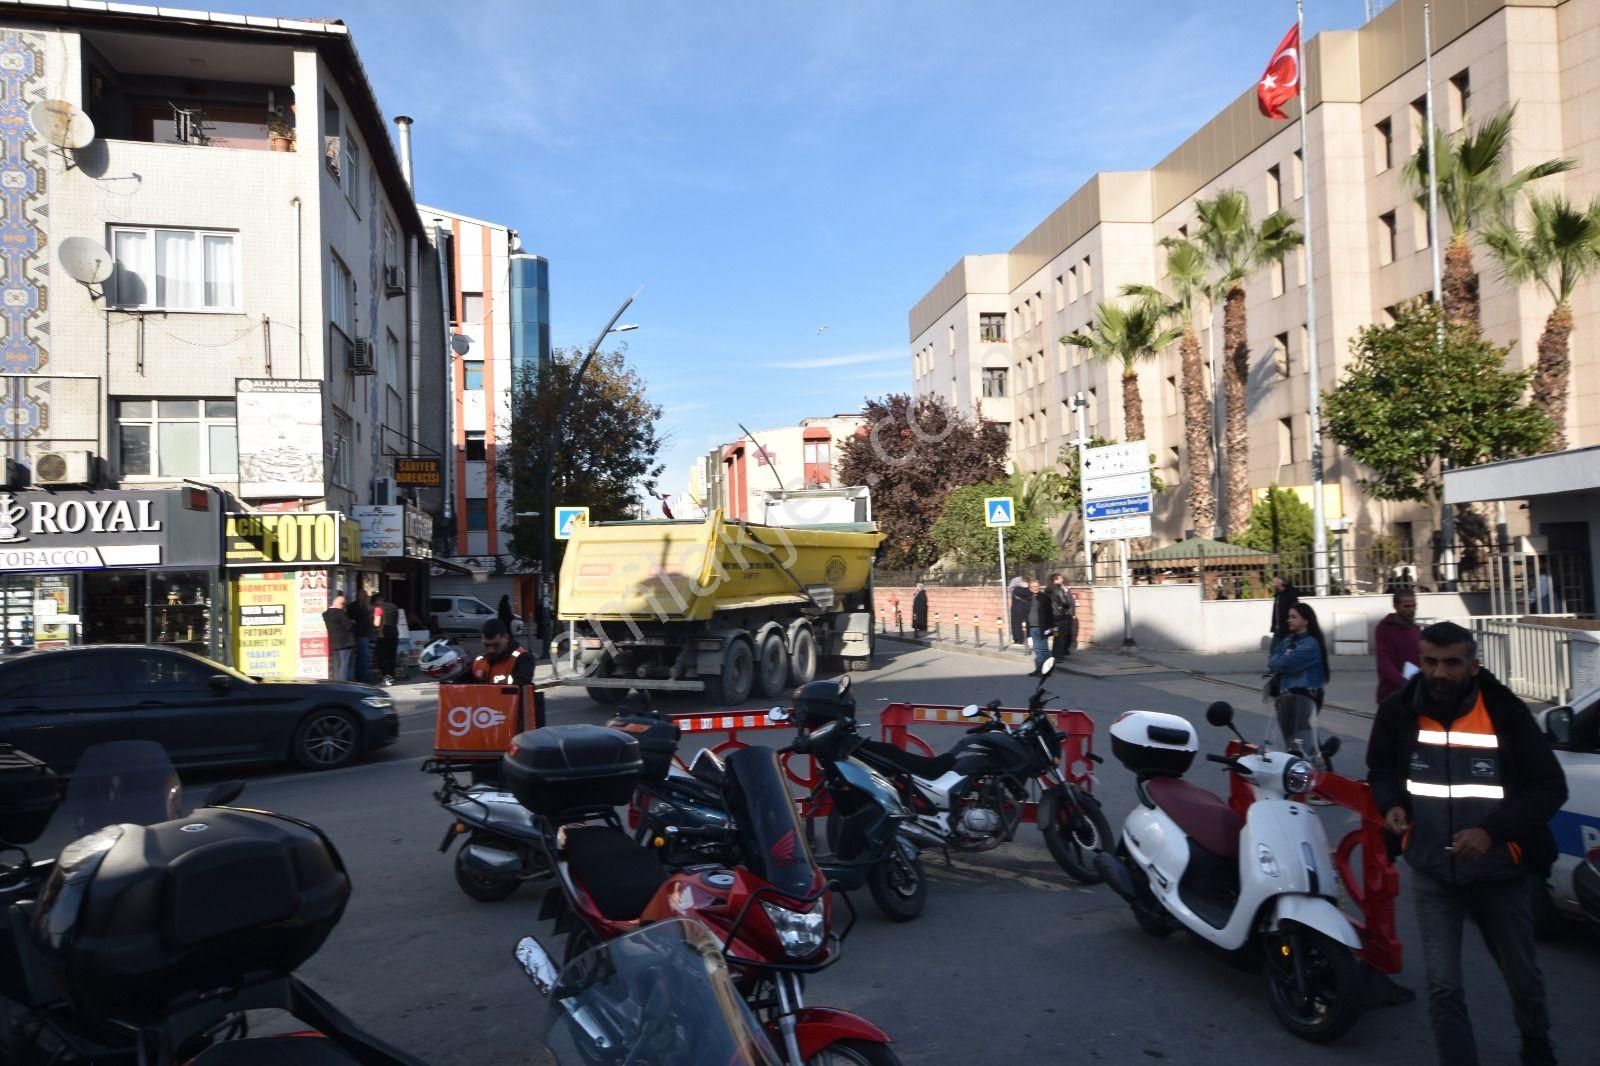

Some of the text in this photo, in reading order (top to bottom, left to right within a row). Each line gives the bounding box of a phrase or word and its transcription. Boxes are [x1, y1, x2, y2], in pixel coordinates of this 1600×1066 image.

[30, 499, 161, 534] ROYAL
[262, 514, 335, 562] FOTO
[447, 706, 506, 737] go
